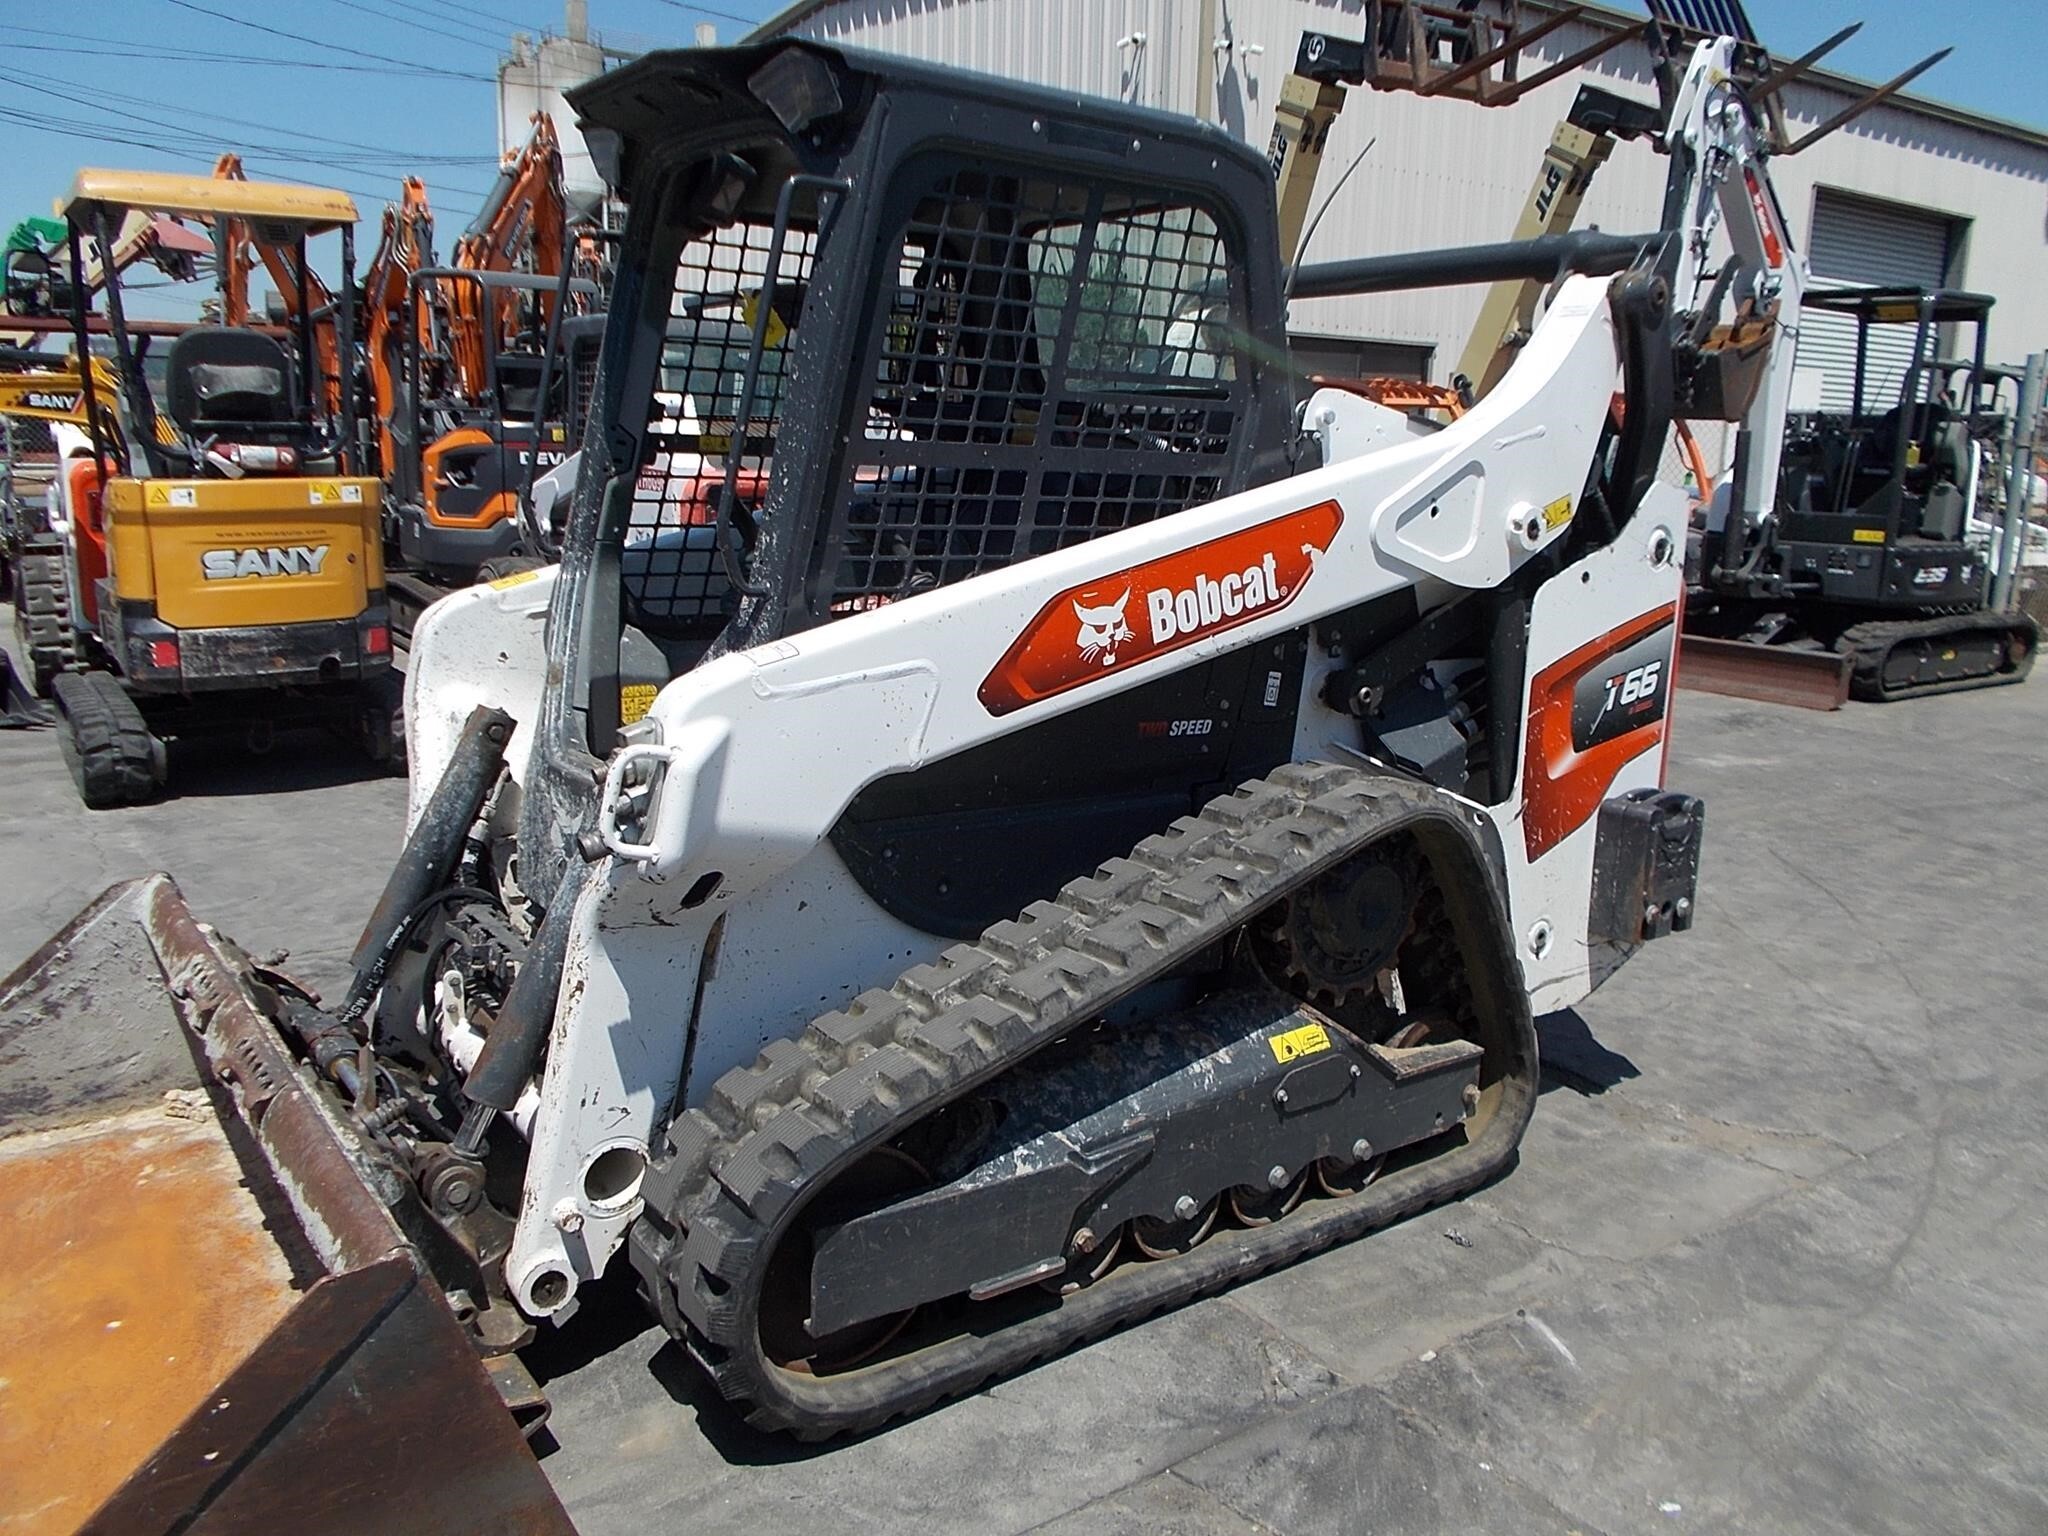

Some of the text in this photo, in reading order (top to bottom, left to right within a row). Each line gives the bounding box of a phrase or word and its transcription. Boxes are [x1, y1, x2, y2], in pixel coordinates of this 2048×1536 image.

[1535, 165, 1562, 223] JLG
[29, 394, 75, 409] SANY
[201, 544, 330, 580] SANY
[1147, 552, 1279, 645] Bobcat
[1605, 660, 1662, 711] T66
[1169, 719, 1212, 736] SPEED
